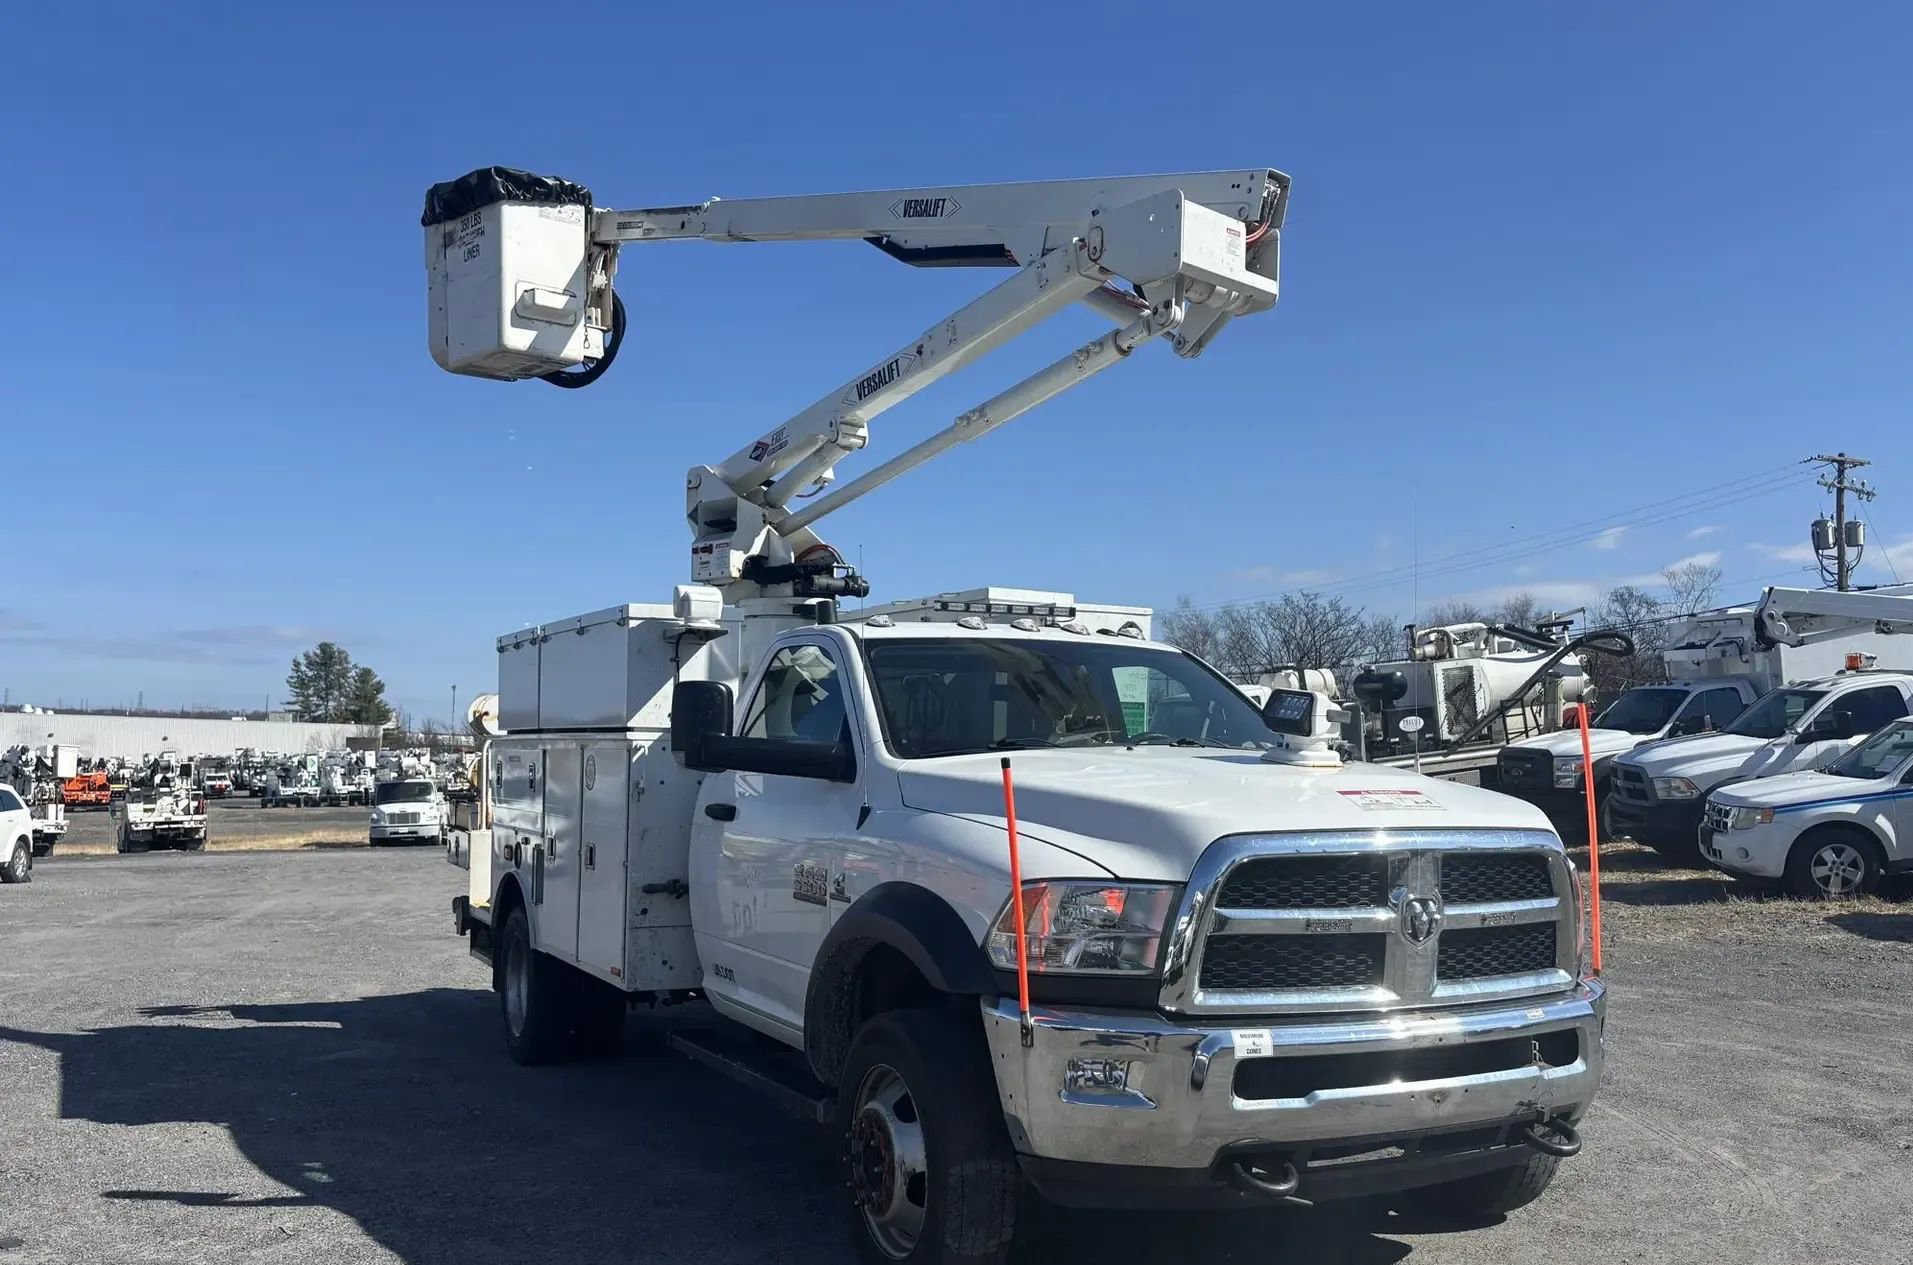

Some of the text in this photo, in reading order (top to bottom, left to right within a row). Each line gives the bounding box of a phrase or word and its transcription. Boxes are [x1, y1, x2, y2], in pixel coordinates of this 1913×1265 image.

[902, 198, 947, 218] VERSALIFT
[470, 211, 482, 229] LBS
[463, 243, 480, 262] LINER
[855, 358, 900, 401] VERSALIFT
[1246, 1047, 1262, 1055] CONES
